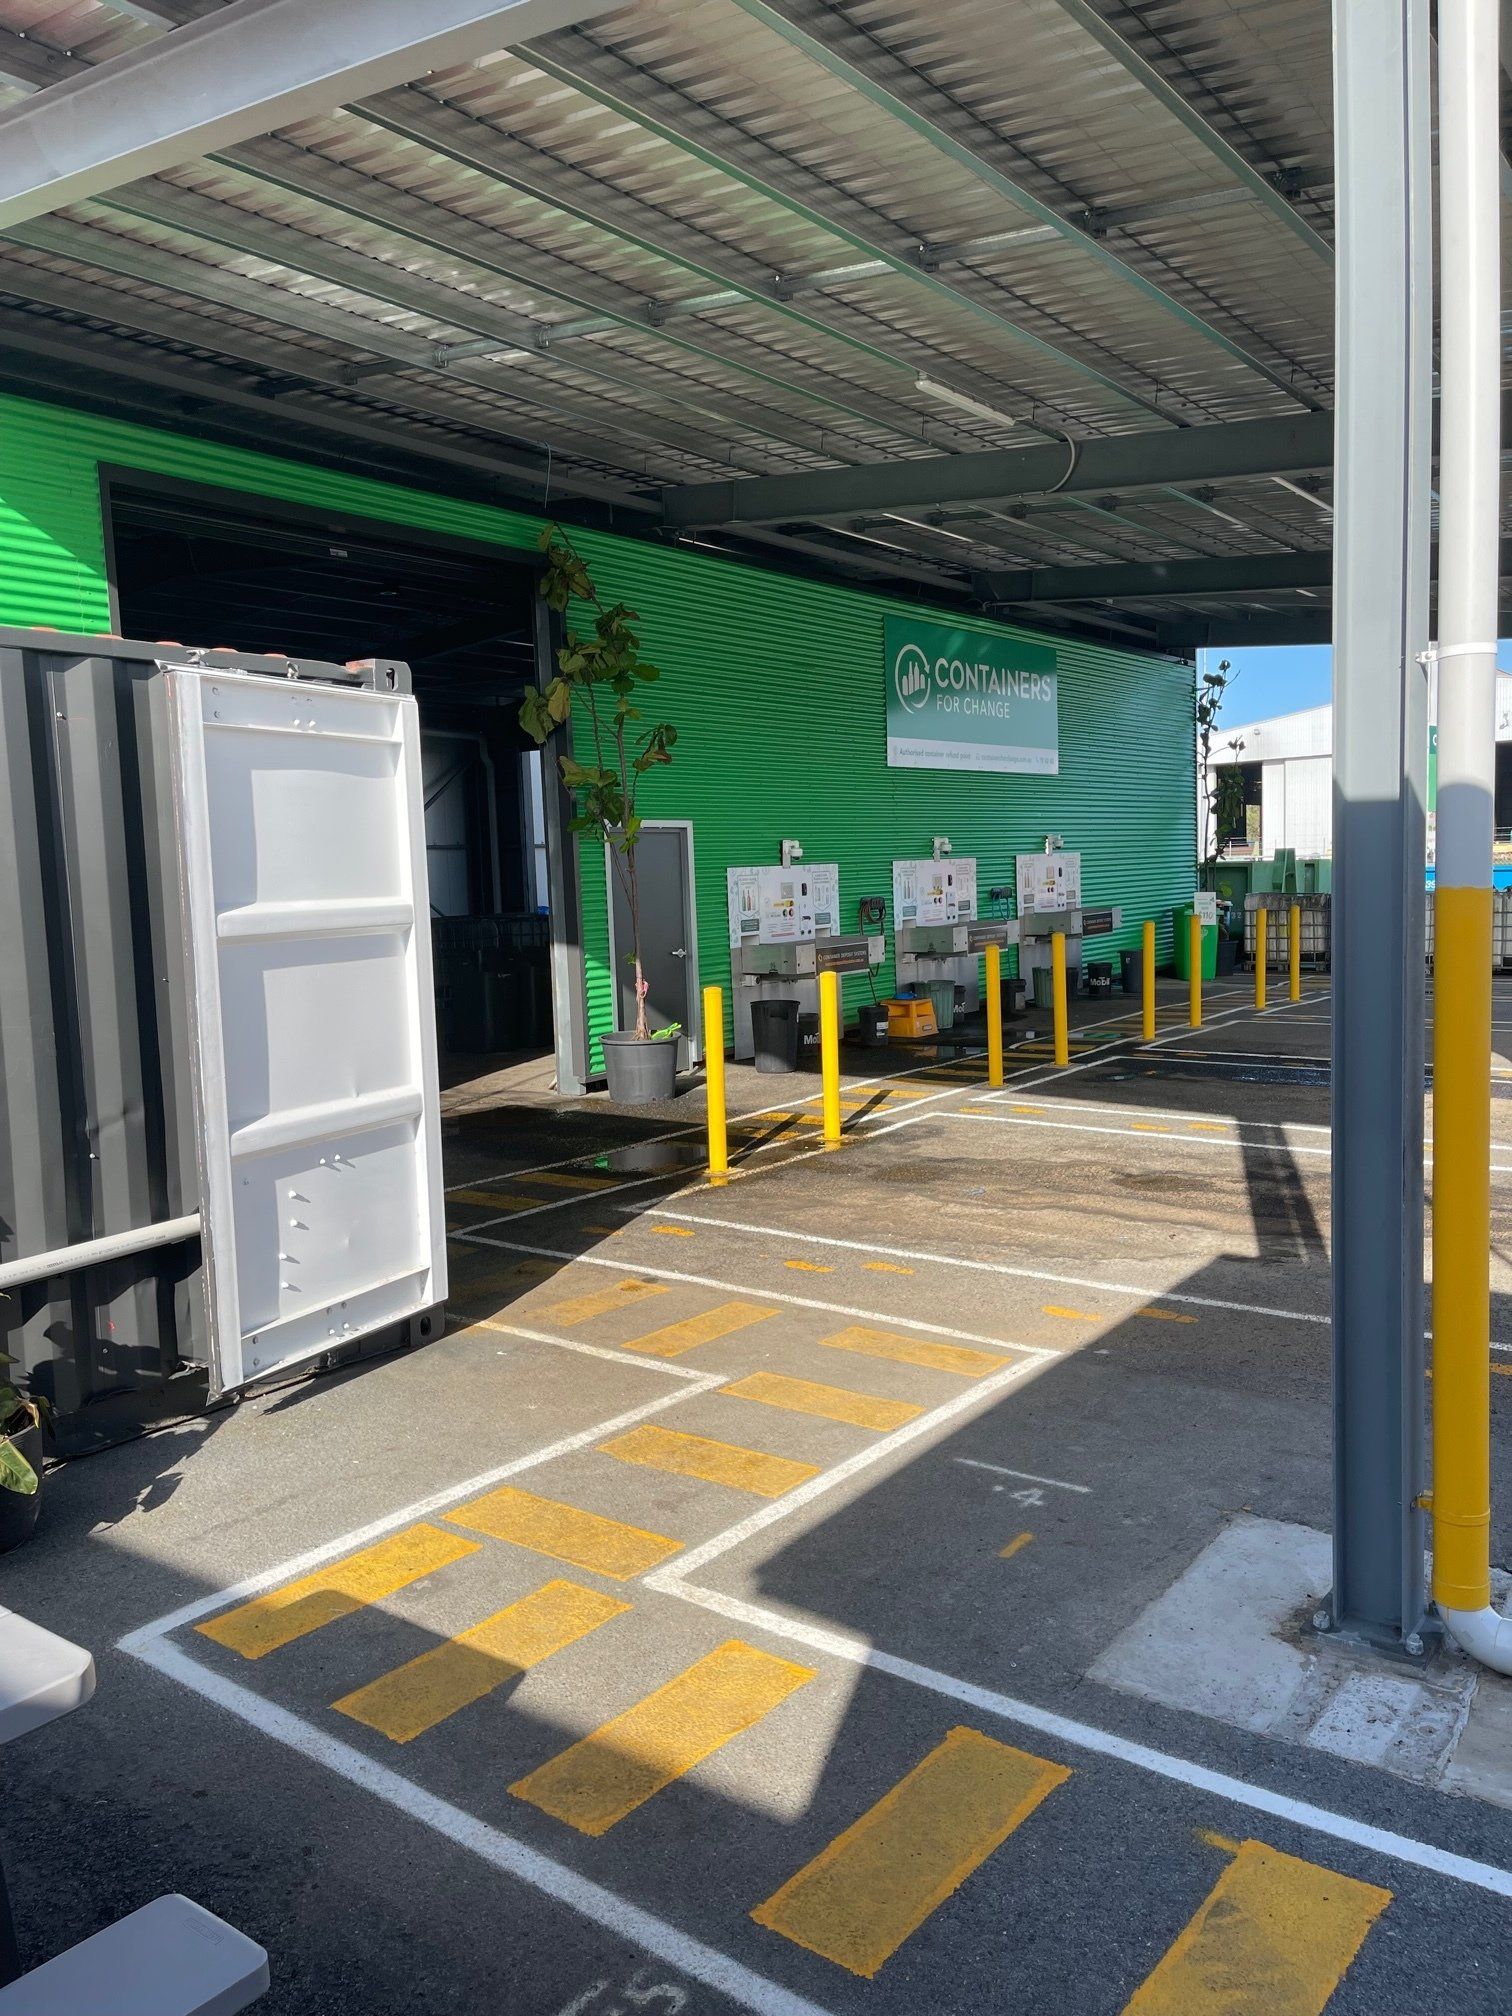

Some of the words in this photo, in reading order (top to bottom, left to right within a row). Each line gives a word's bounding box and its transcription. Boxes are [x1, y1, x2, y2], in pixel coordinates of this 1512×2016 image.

[934, 657, 1052, 702] CONTAINERS
[937, 694, 960, 714] FOR
[963, 697, 1010, 719] CHANGE
